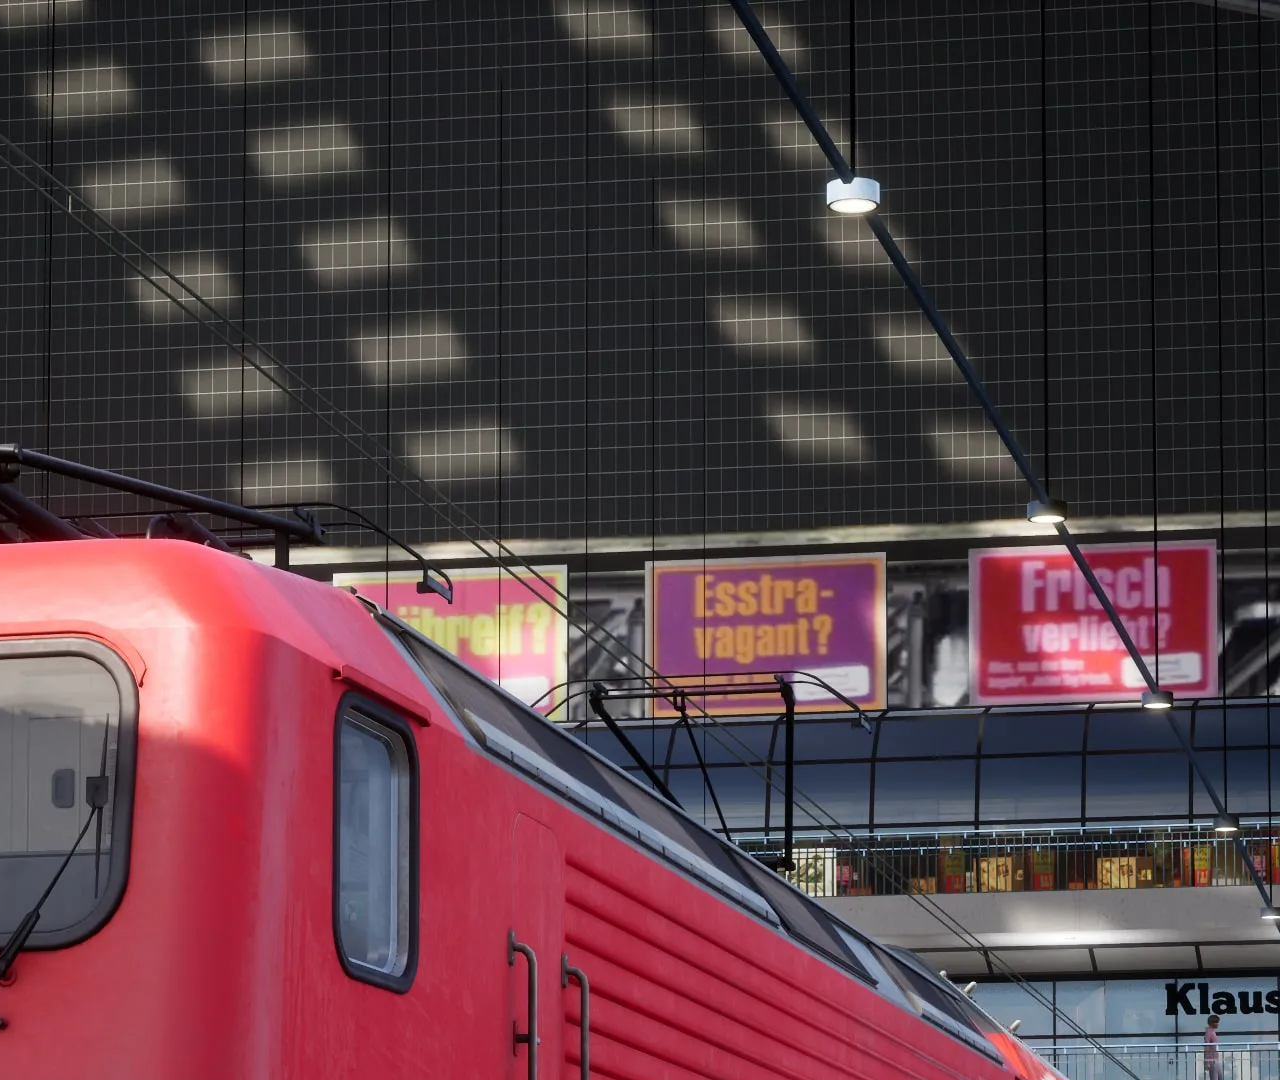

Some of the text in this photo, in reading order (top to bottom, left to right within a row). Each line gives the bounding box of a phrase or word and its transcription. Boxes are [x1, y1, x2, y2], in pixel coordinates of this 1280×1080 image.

[693, 574, 835, 619] Esstra-
[1021, 557, 1171, 612] Frisch
[693, 613, 833, 665] vagant?
